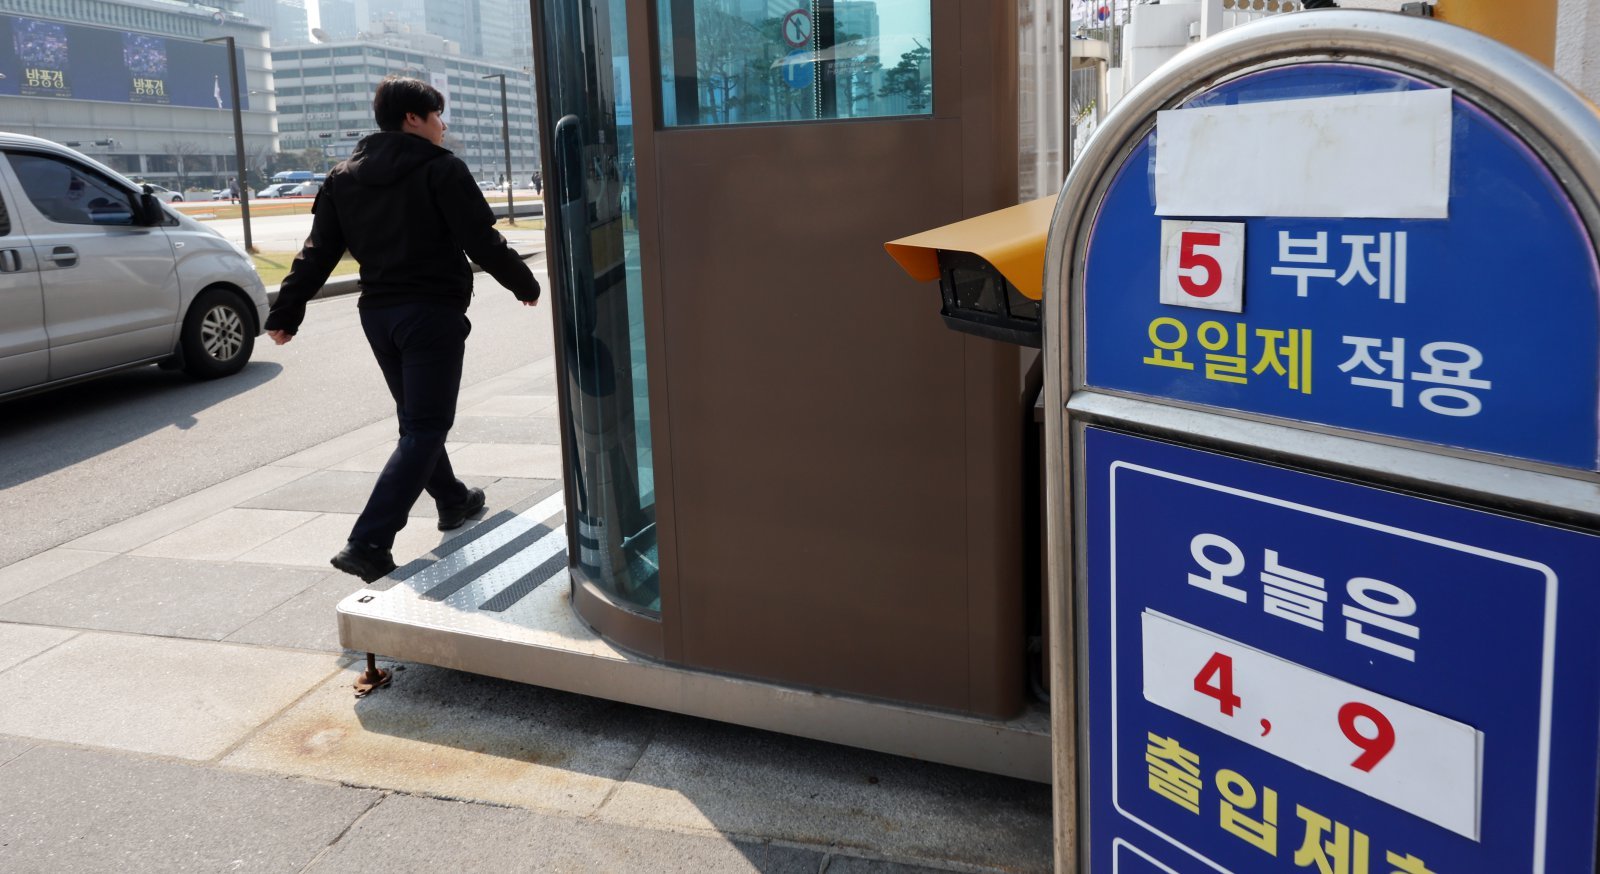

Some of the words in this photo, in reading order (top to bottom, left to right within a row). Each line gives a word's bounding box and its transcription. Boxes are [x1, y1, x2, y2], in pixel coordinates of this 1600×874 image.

[25, 68, 64, 88] 밤풍경
[133, 78, 164, 96] 밤풍경
[1178, 231, 1222, 298] 5
[1271, 231, 1407, 303] 부제
[1143, 316, 1312, 394] 요일제
[1338, 335, 1492, 417] 적용
[1187, 533, 1420, 662] 오늘은
[1193, 652, 1272, 737] 4,
[1337, 702, 1396, 773] 9
